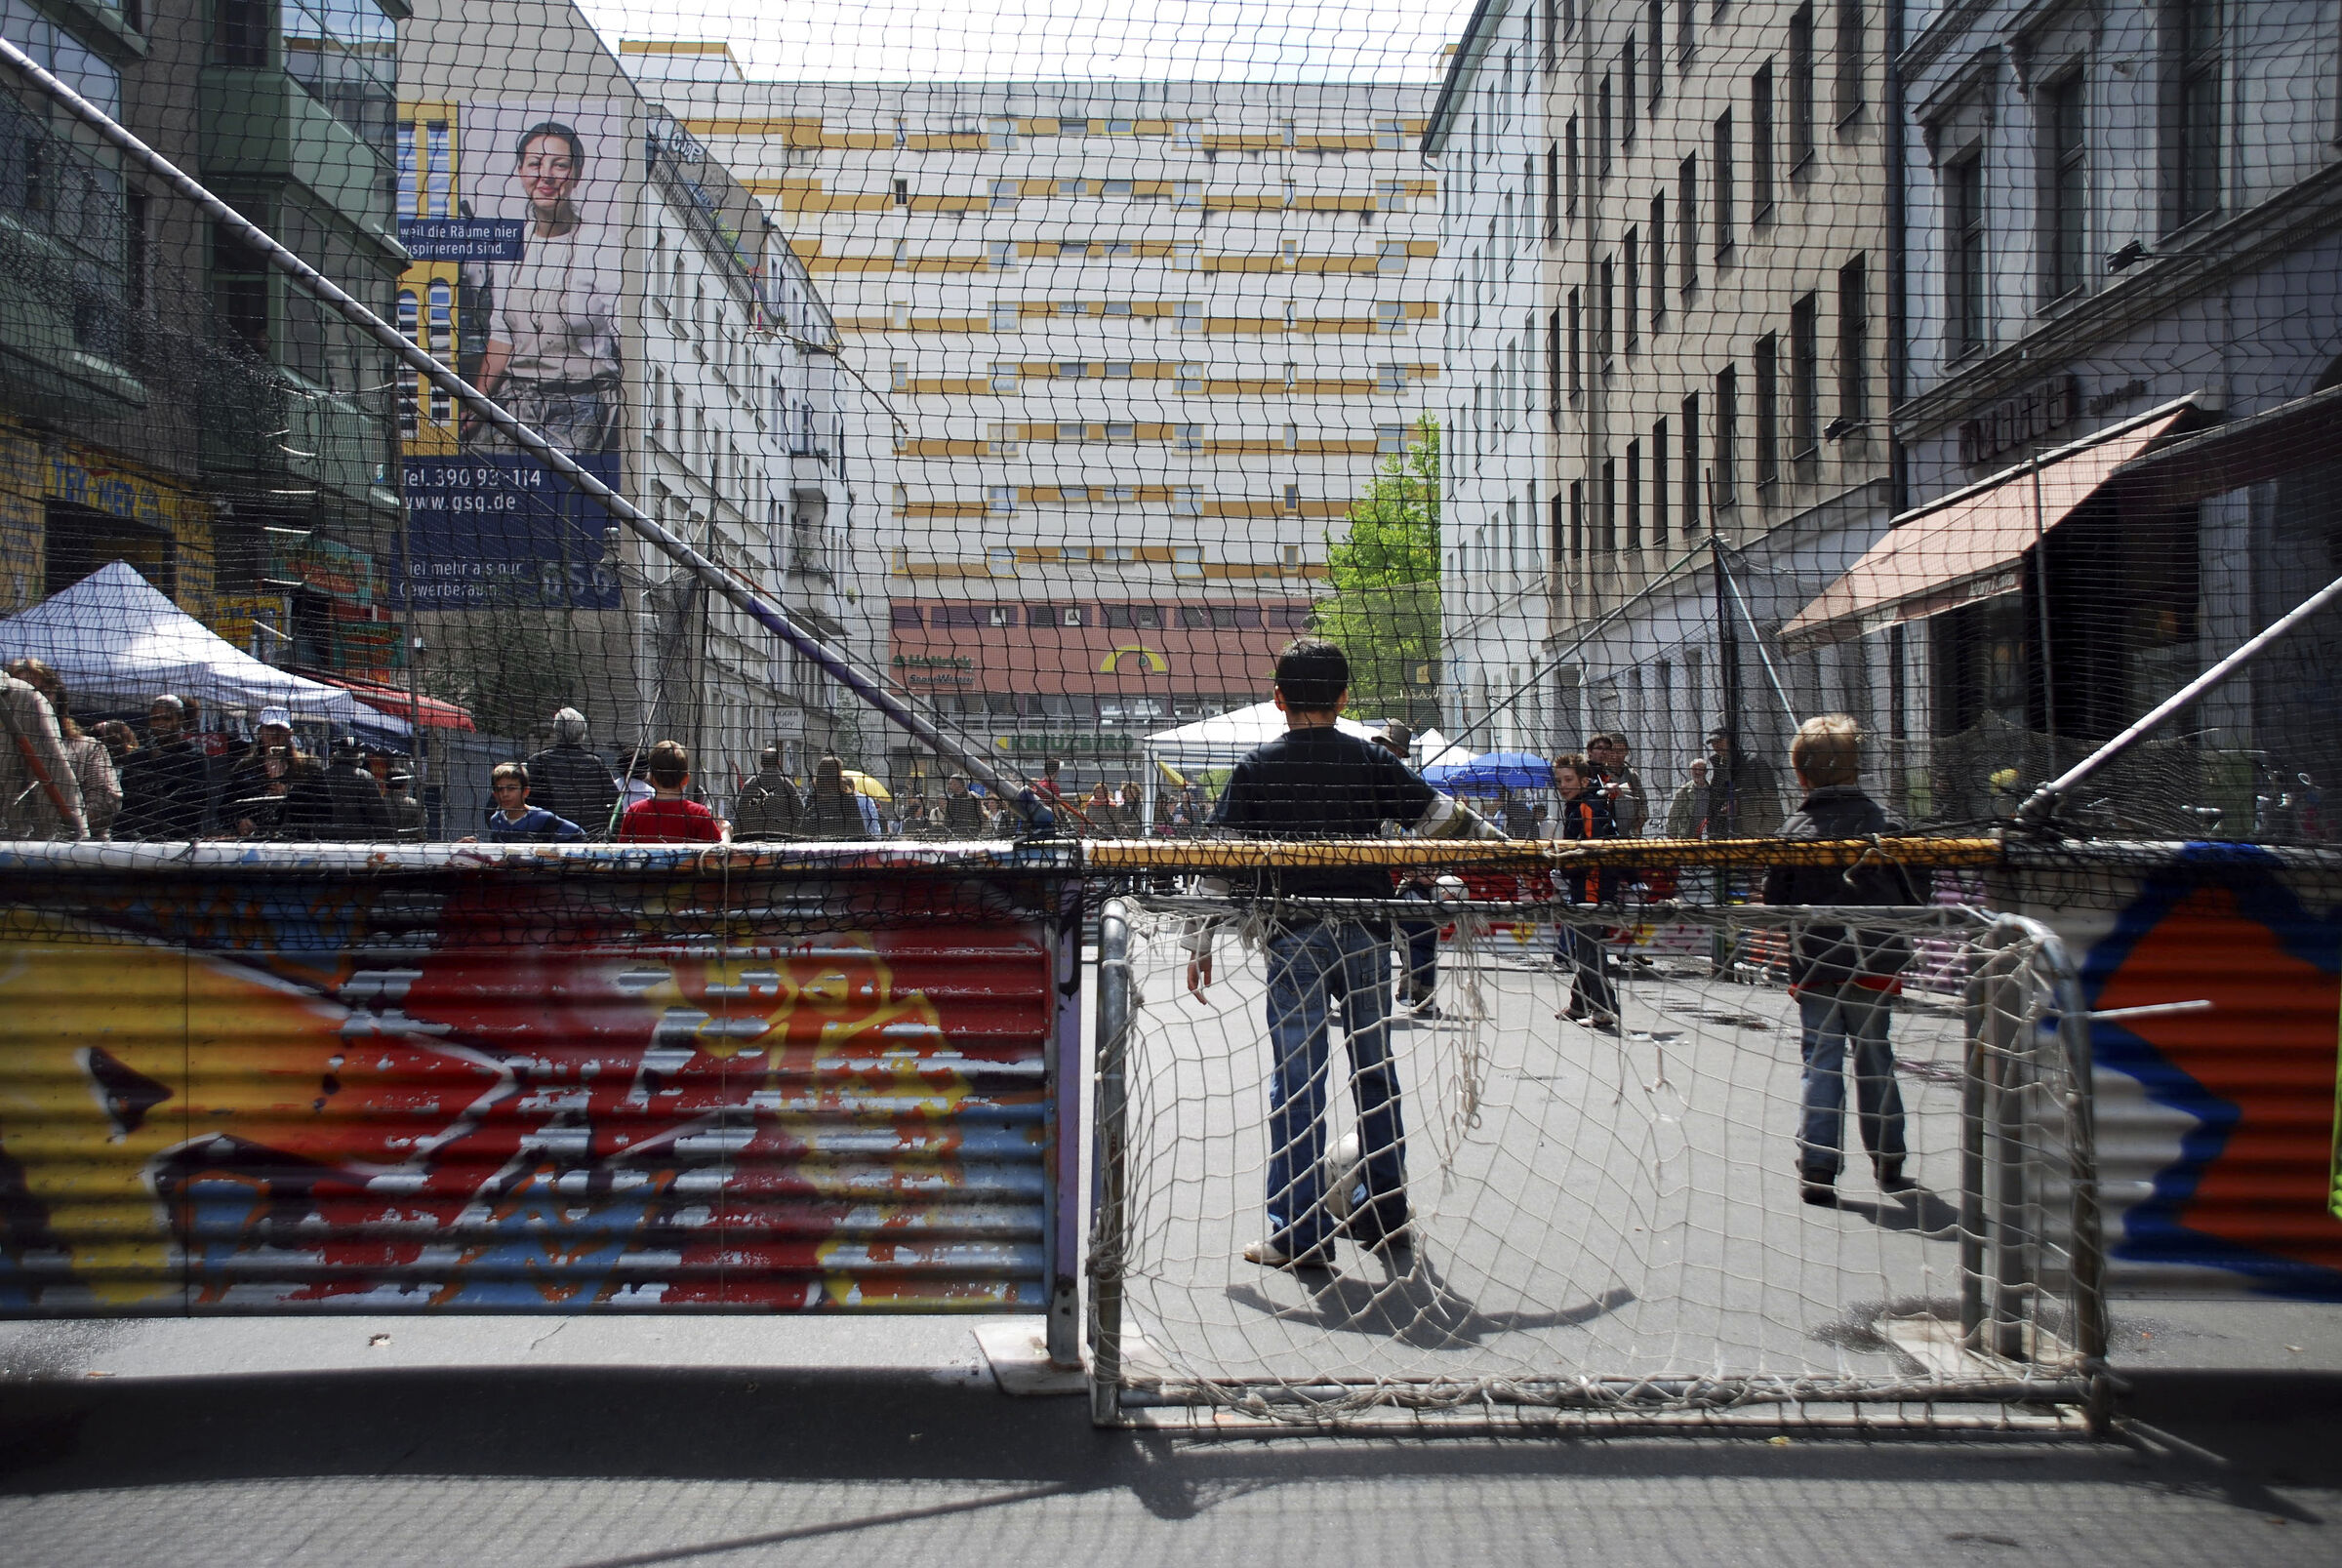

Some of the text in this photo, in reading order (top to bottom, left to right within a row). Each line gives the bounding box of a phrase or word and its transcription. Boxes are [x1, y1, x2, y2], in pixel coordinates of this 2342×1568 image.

[400, 225, 424, 237] weil
[428, 225, 446, 238] die
[451, 225, 490, 238] Räume
[401, 242, 505, 257] nspirierend sind.
[402, 468, 429, 486] Tel.
[435, 468, 470, 486] 390
[408, 561, 425, 576] iel
[431, 561, 467, 576] mehr
[473, 562, 493, 576] as
[1011, 733, 1134, 751] KREUZBERG
